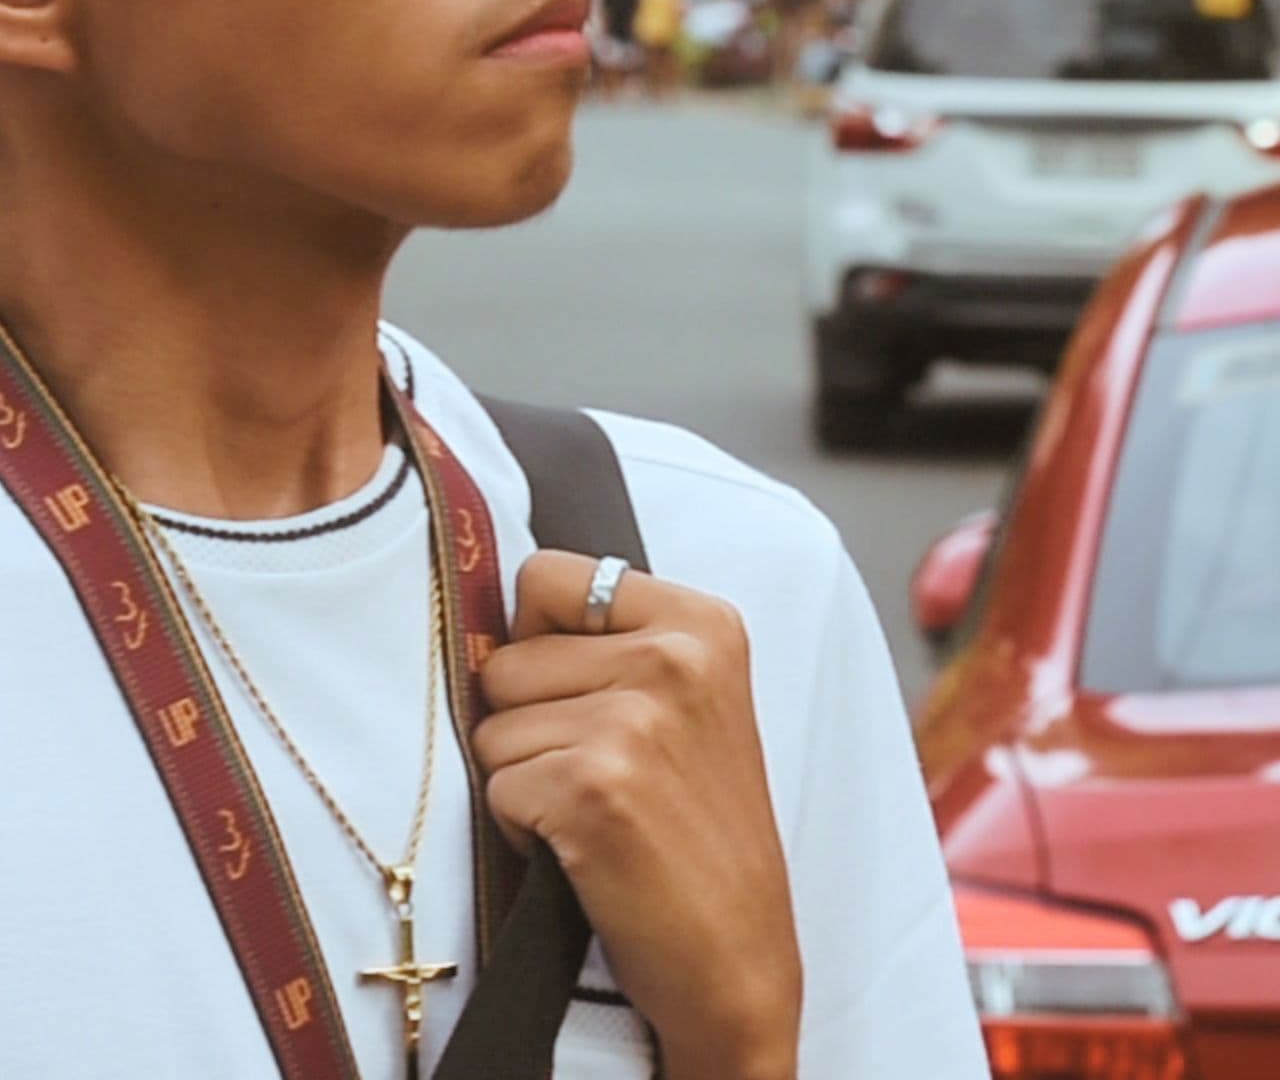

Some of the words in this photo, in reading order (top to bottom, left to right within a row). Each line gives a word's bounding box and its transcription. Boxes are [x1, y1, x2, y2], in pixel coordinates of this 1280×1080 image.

[44, 484, 90, 532] UP
[157, 697, 200, 747] UP
[274, 977, 313, 1029] UP
